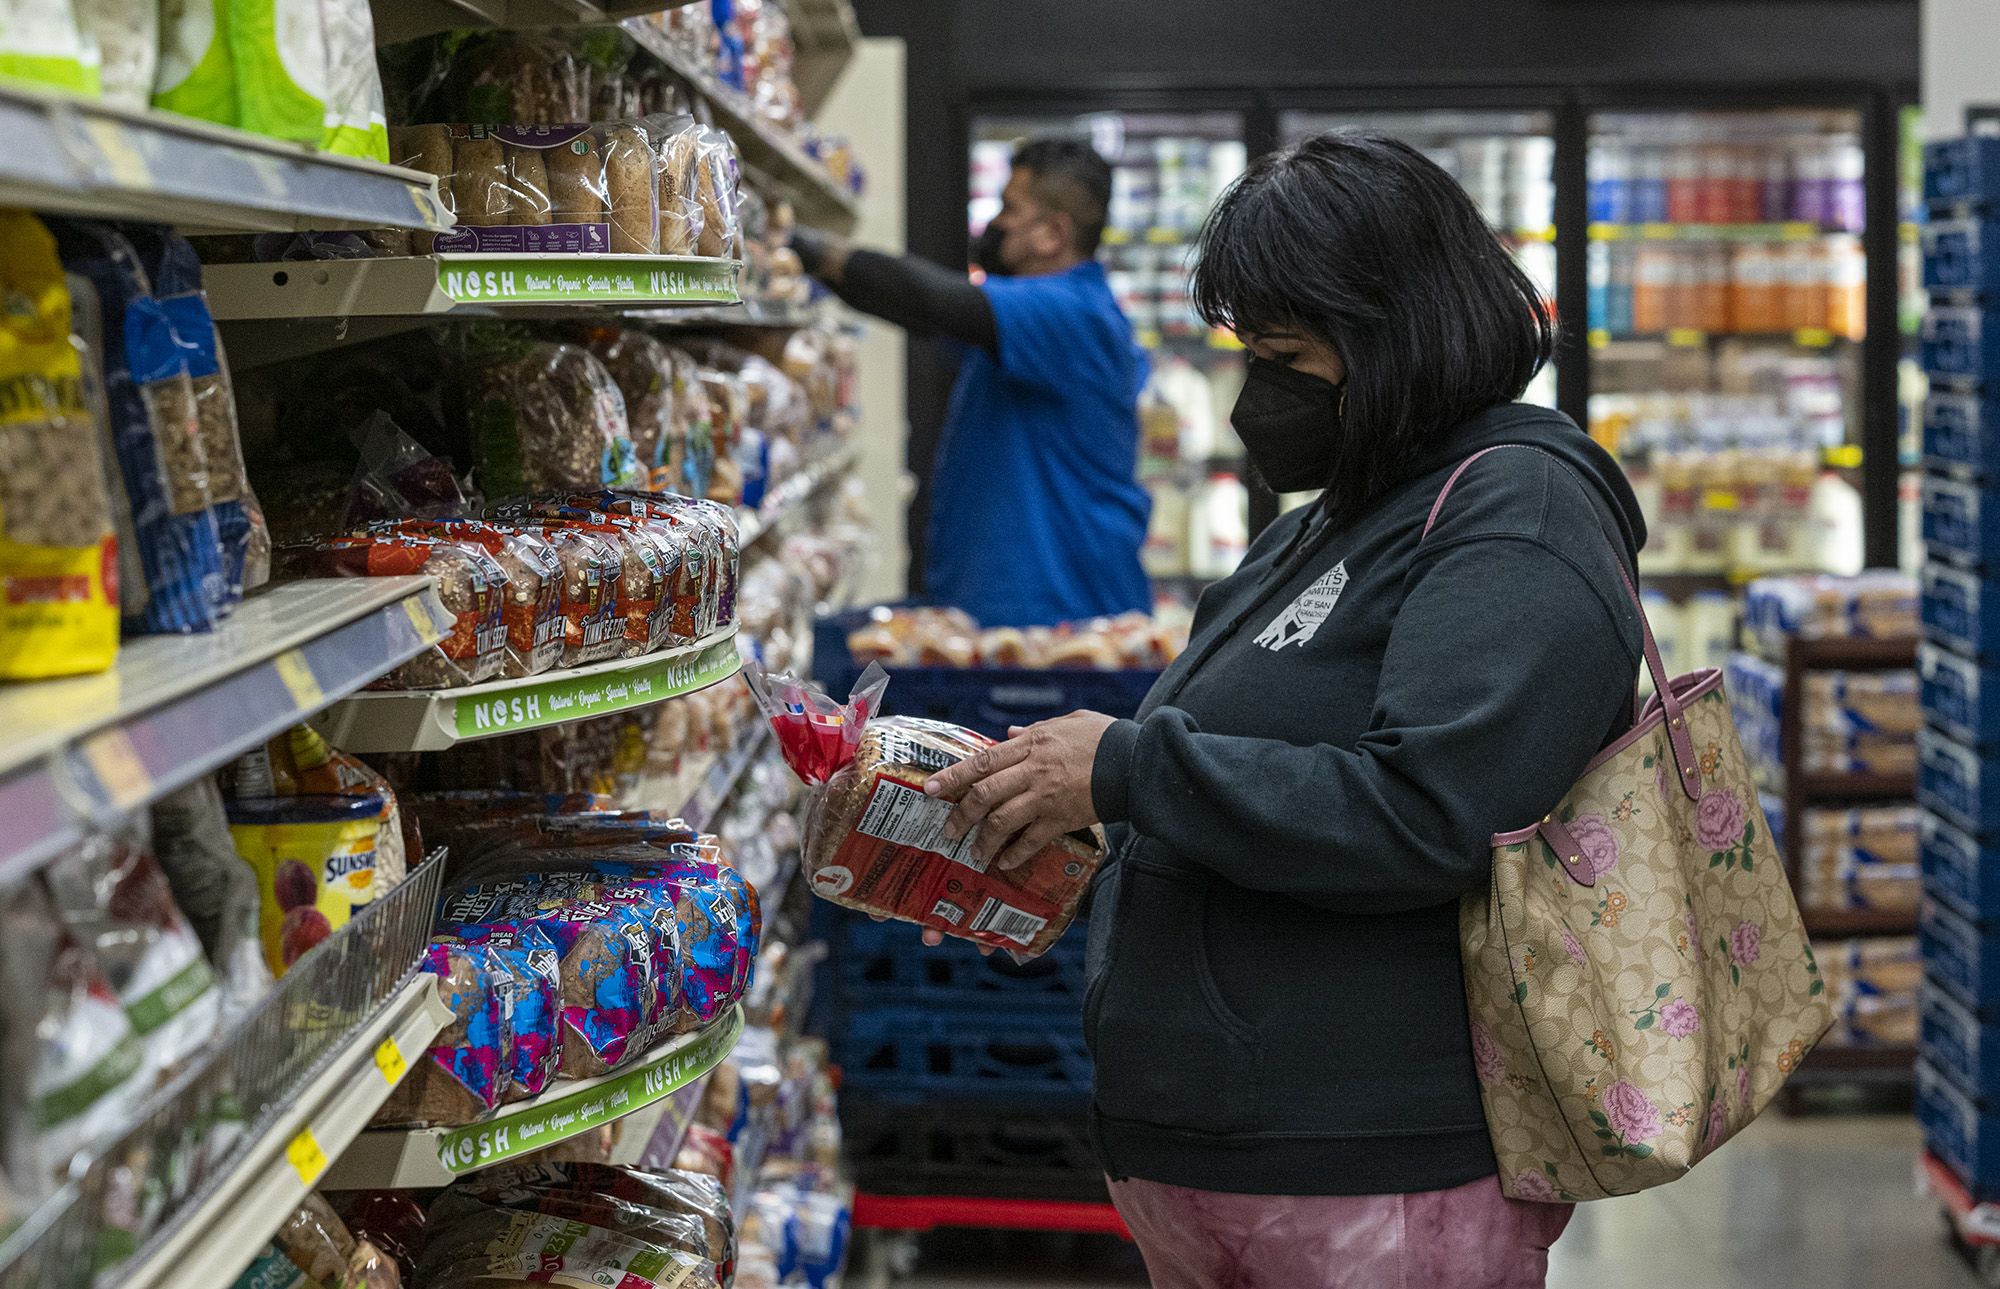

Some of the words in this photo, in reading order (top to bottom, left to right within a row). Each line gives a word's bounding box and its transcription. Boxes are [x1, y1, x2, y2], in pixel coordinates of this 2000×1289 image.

[447, 271, 517, 298] NOSH
[525, 274, 551, 291] Natural
[557, 274, 581, 295] Organic
[650, 271, 686, 295] NOSH
[1315, 601, 1332, 610] SAN
[667, 661, 697, 690] NOSH
[475, 694, 541, 729] NOSH
[548, 692, 573, 711] Natural
[578, 689, 601, 709] Organic
[859, 805, 877, 832] Nutrition
[873, 784, 886, 804] Facts
[883, 814, 901, 839] Calories
[899, 789, 912, 807] 100
[645, 1057, 682, 1096] NOSH
[519, 1118, 545, 1140] Natural
[550, 1110, 576, 1132] Organic
[441, 1126, 510, 1170] NOSH
